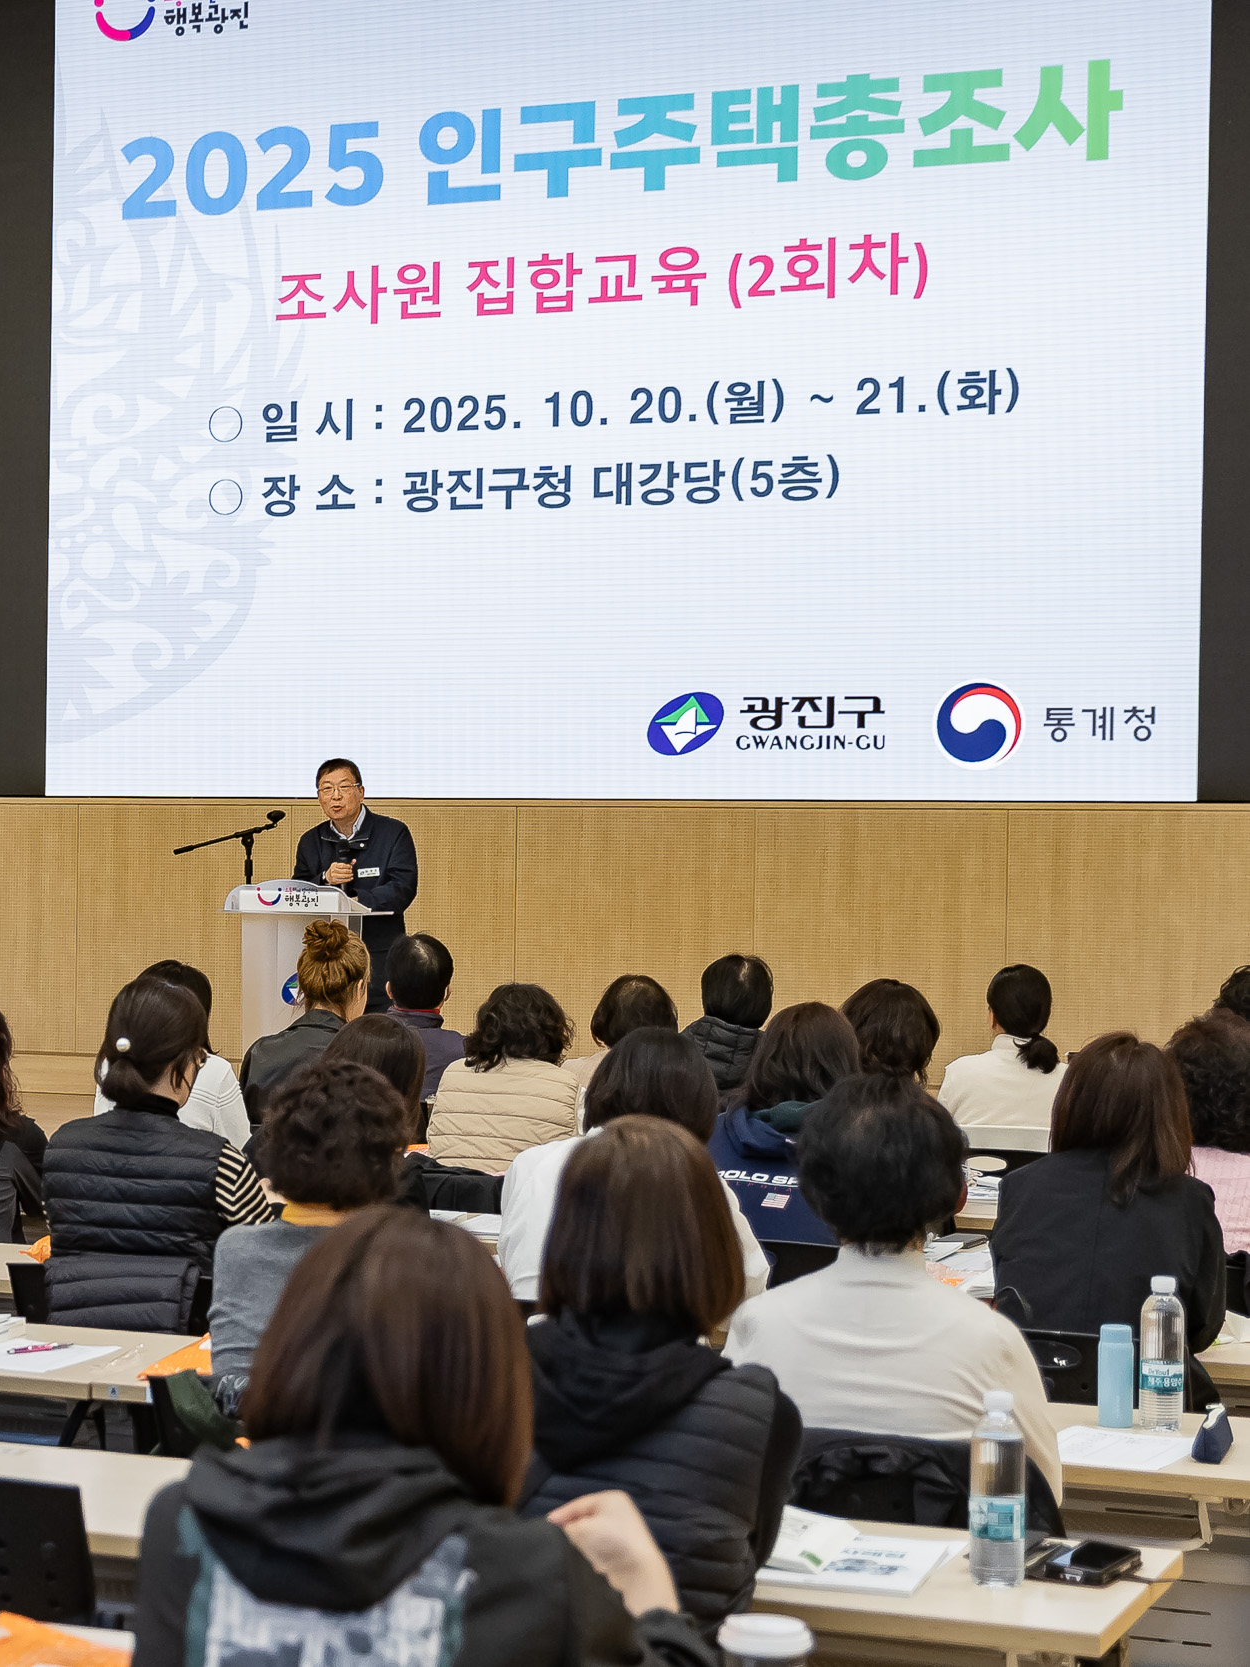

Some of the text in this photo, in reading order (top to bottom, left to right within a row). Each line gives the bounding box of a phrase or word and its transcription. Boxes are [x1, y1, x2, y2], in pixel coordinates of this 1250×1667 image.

[163, 1, 249, 37] 행복광진
[120, 59, 1123, 220] 2025 인구주택총조사
[275, 232, 928, 324] 조사원 집합교육 (2회차)
[262, 401, 298, 443] 일
[316, 398, 353, 441] 시
[403, 395, 521, 433] 2025.
[545, 391, 608, 428] 10.
[629, 378, 784, 425] 20.(월)
[856, 368, 1020, 416] 21.(화)
[262, 475, 300, 517] 장
[315, 474, 356, 511] 소
[402, 464, 572, 513] 광진구청
[593, 455, 840, 506] 대강당(5층)
[739, 695, 885, 732] 광진구
[1043, 706, 1157, 743] 통계청
[736, 734, 886, 751] GWANGJIN-GU
[284, 893, 319, 908] 행복광진
